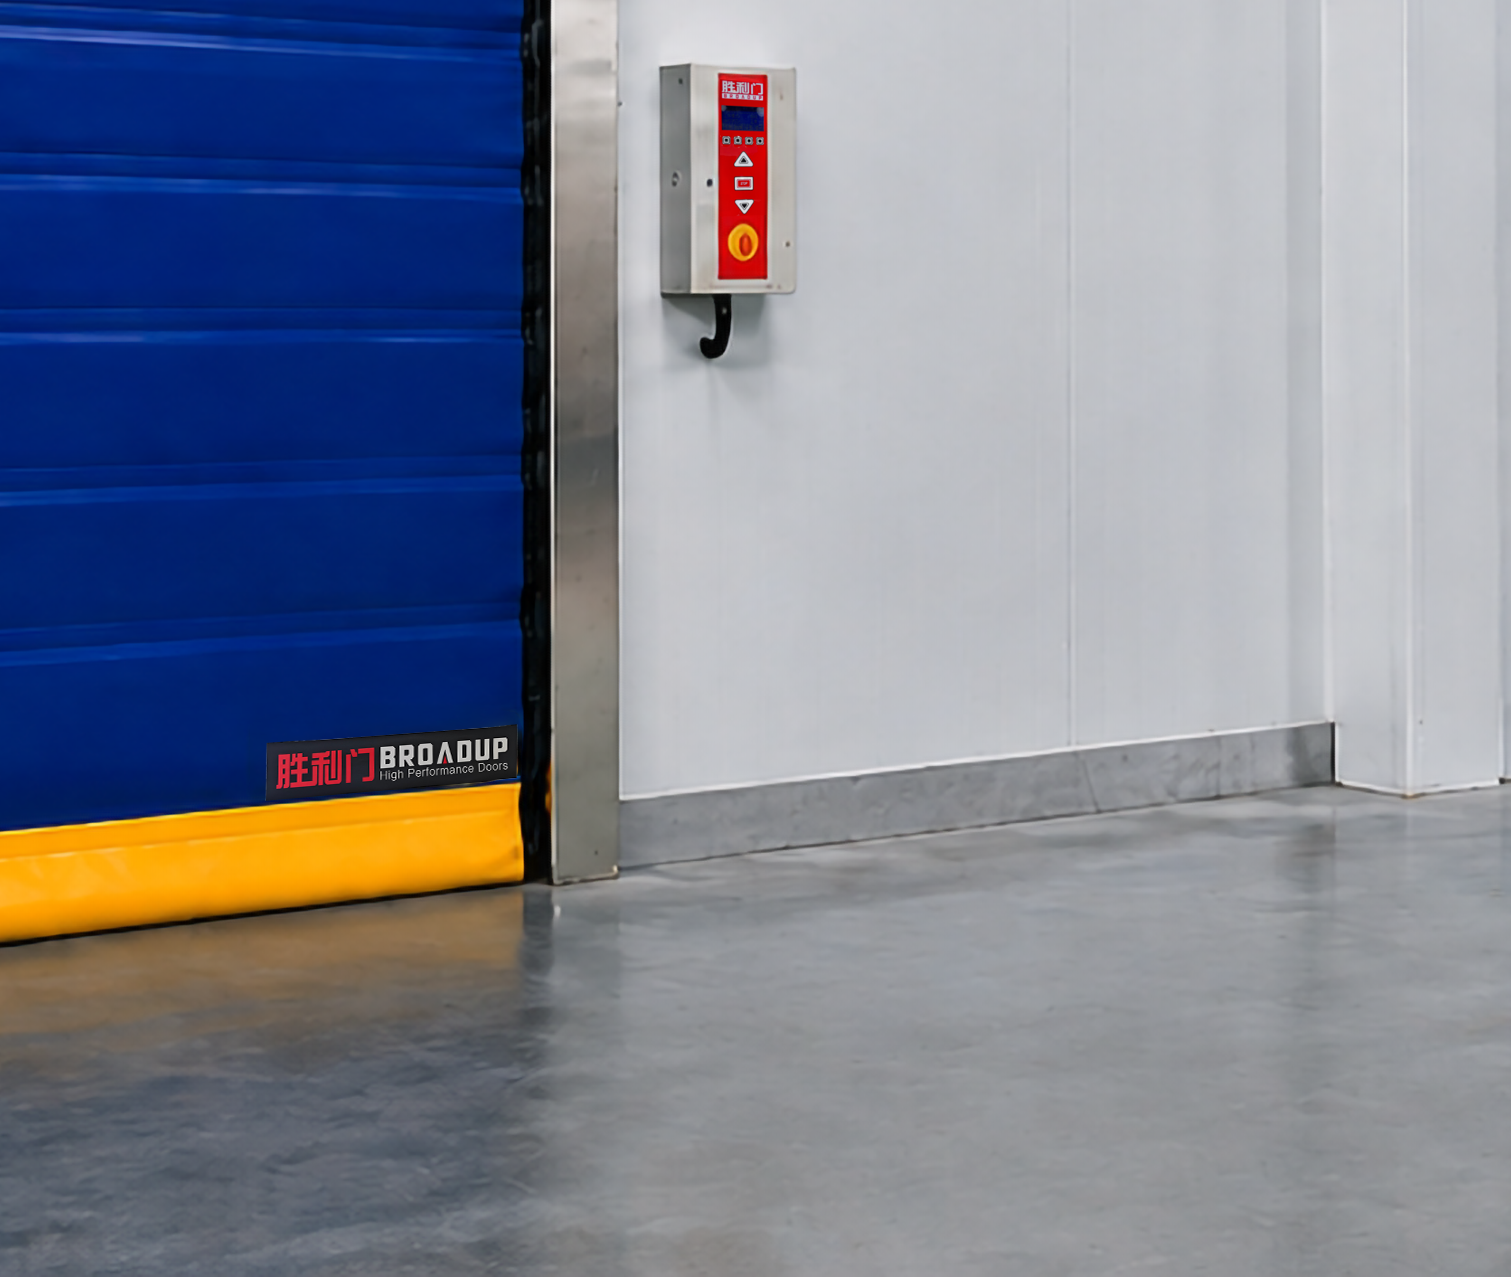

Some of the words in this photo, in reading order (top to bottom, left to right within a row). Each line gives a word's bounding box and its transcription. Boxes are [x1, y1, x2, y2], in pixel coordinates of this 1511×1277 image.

[721, 80, 764, 95] 胜利门
[380, 737, 508, 769] BROADUP
[276, 747, 375, 790] 胜利门
[379, 769, 404, 782] High
[407, 764, 475, 778] Performance
[477, 762, 509, 773] Doors
